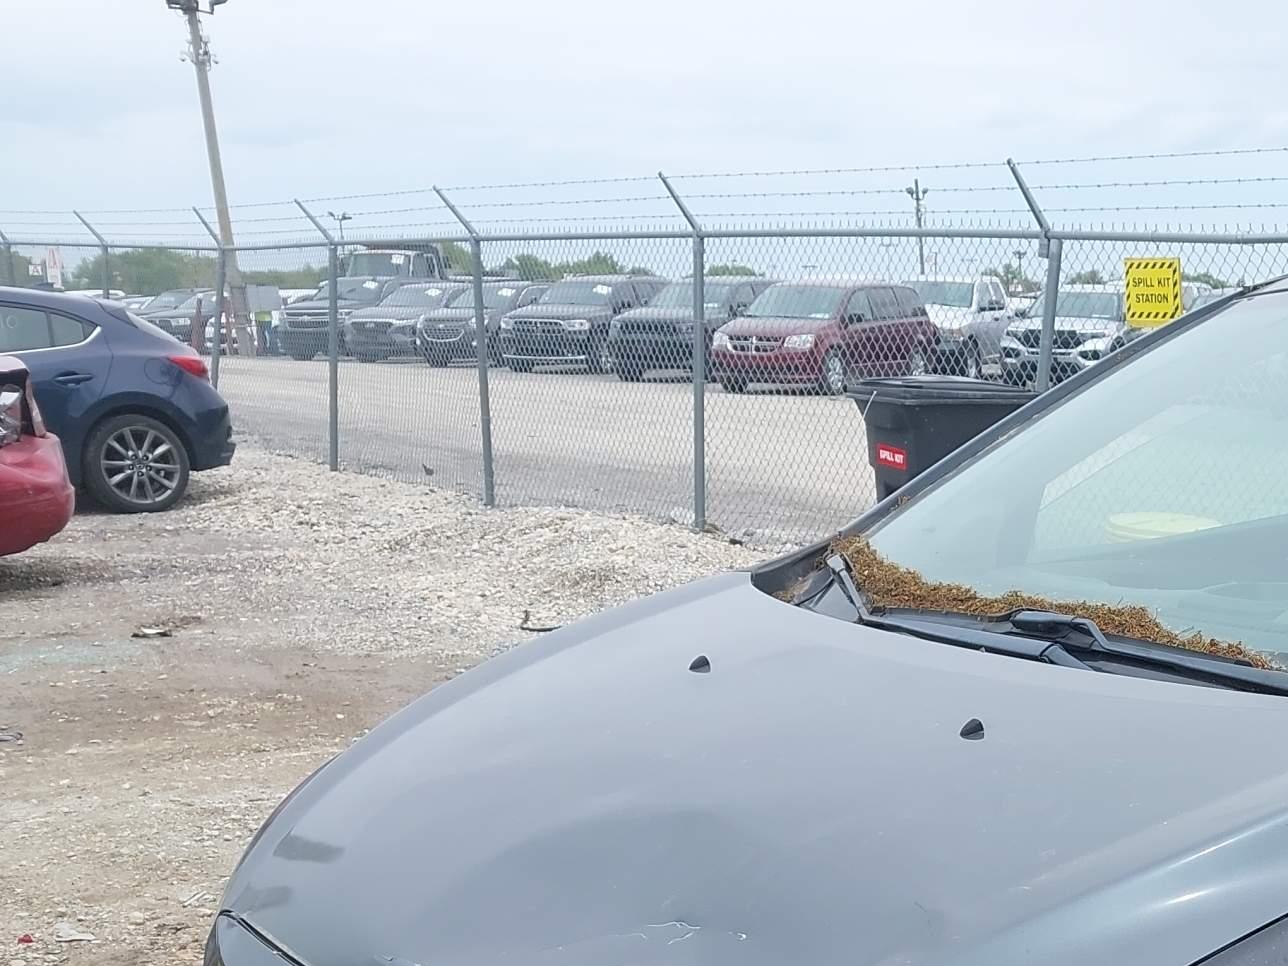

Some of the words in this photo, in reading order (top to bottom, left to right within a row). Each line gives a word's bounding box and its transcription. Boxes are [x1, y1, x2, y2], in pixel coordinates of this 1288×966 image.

[1132, 276, 1155, 288] SPILL
[1157, 277, 1171, 288] KIT
[1135, 293, 1169, 304] STATION
